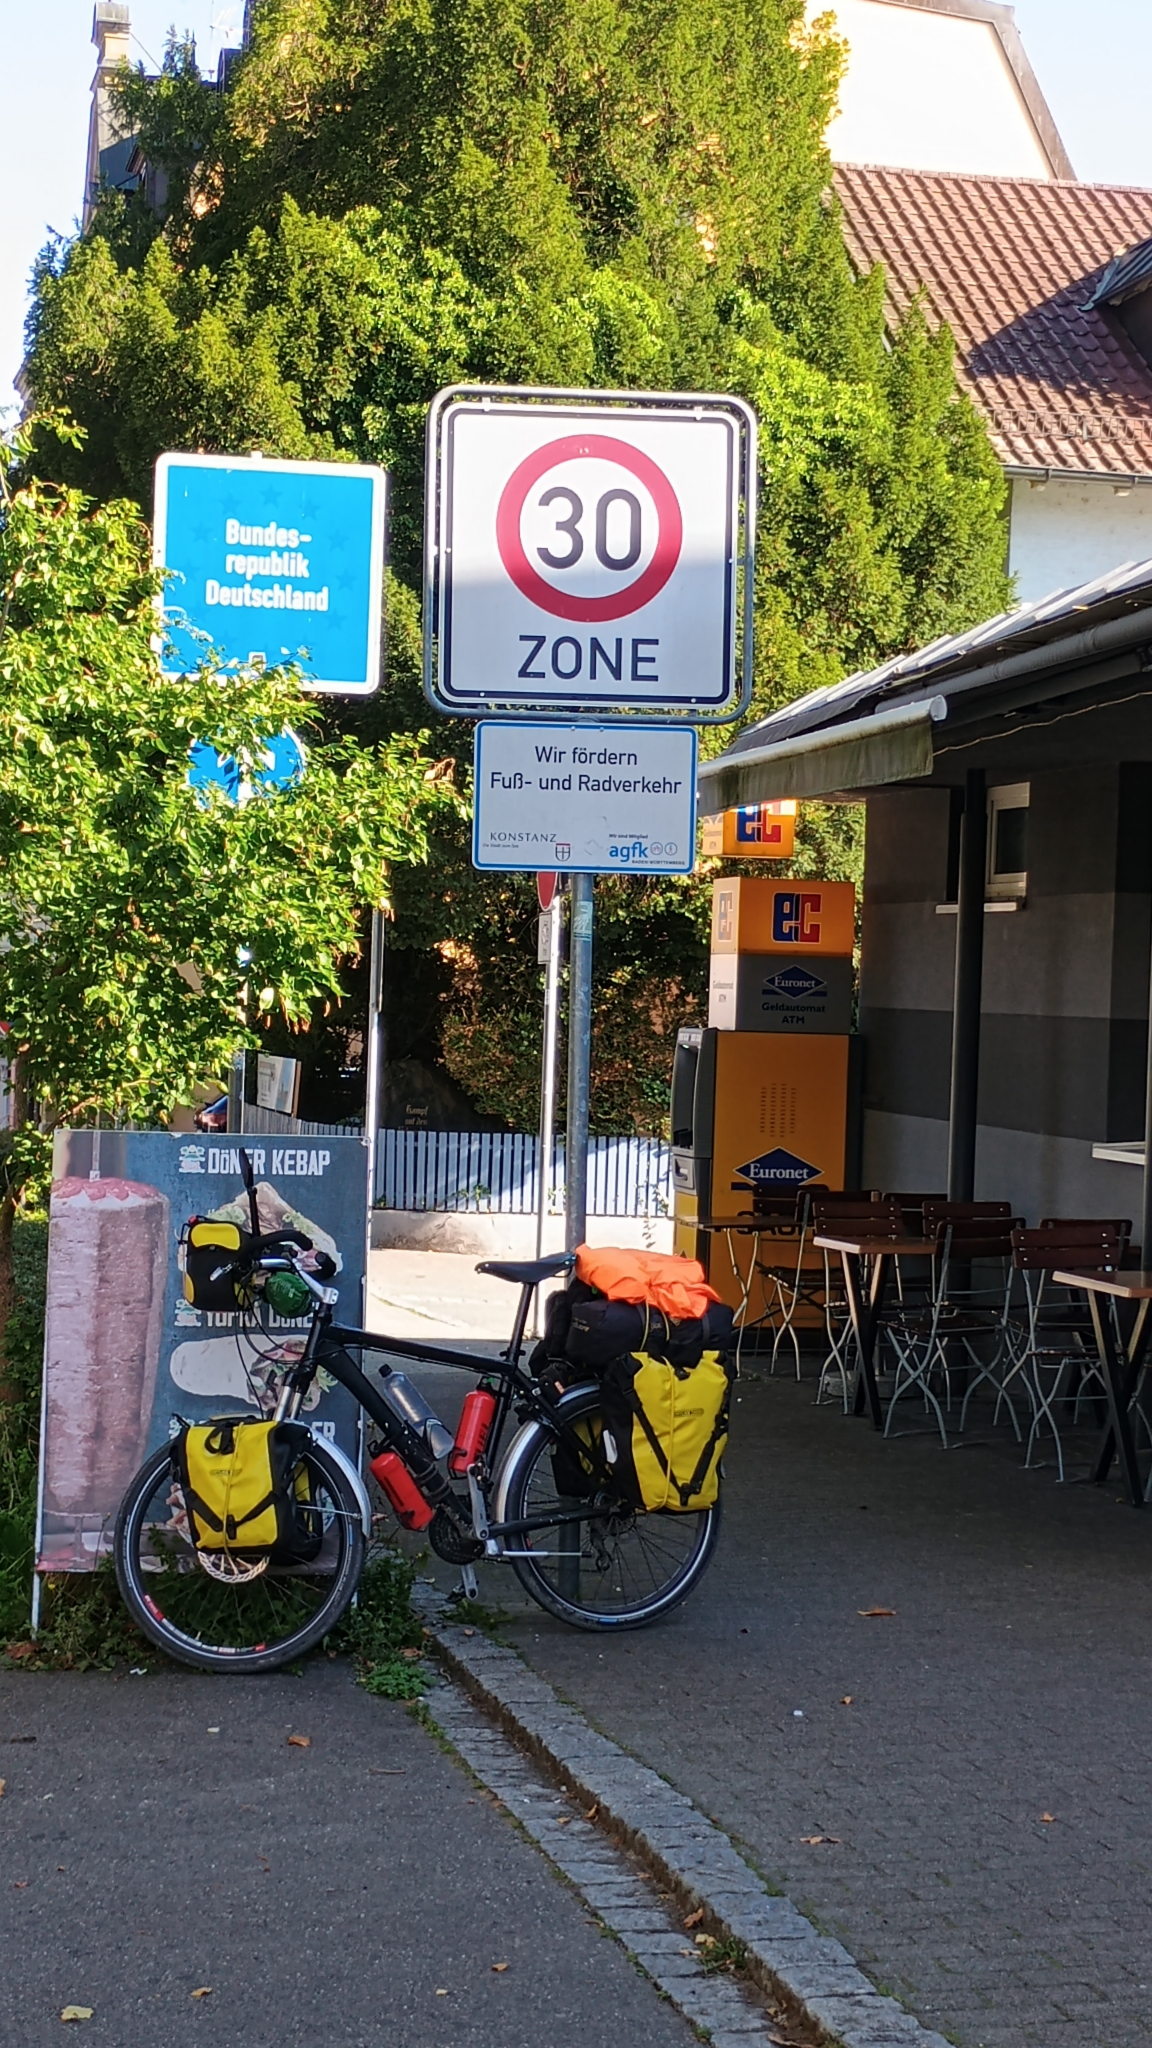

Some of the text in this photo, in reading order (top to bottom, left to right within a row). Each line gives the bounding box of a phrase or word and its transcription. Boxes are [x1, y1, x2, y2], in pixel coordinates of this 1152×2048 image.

[225, 518, 312, 548] Bundes-
[536, 486, 642, 571] 30
[225, 551, 310, 581] republik
[205, 580, 329, 612] Deutschland
[517, 634, 660, 682] ZONE
[535, 746, 638, 765] Wir fördern
[490, 772, 682, 794] Fuß- und Radverkehr
[490, 832, 557, 842] KONSTANZ
[609, 841, 648, 862] agfk
[774, 976, 816, 988] Euronet
[762, 1002, 826, 1013] Geldautomat
[781, 1016, 805, 1024] ATM
[271, 1149, 330, 1176] KEBAP
[749, 1163, 809, 1179] Euronet
